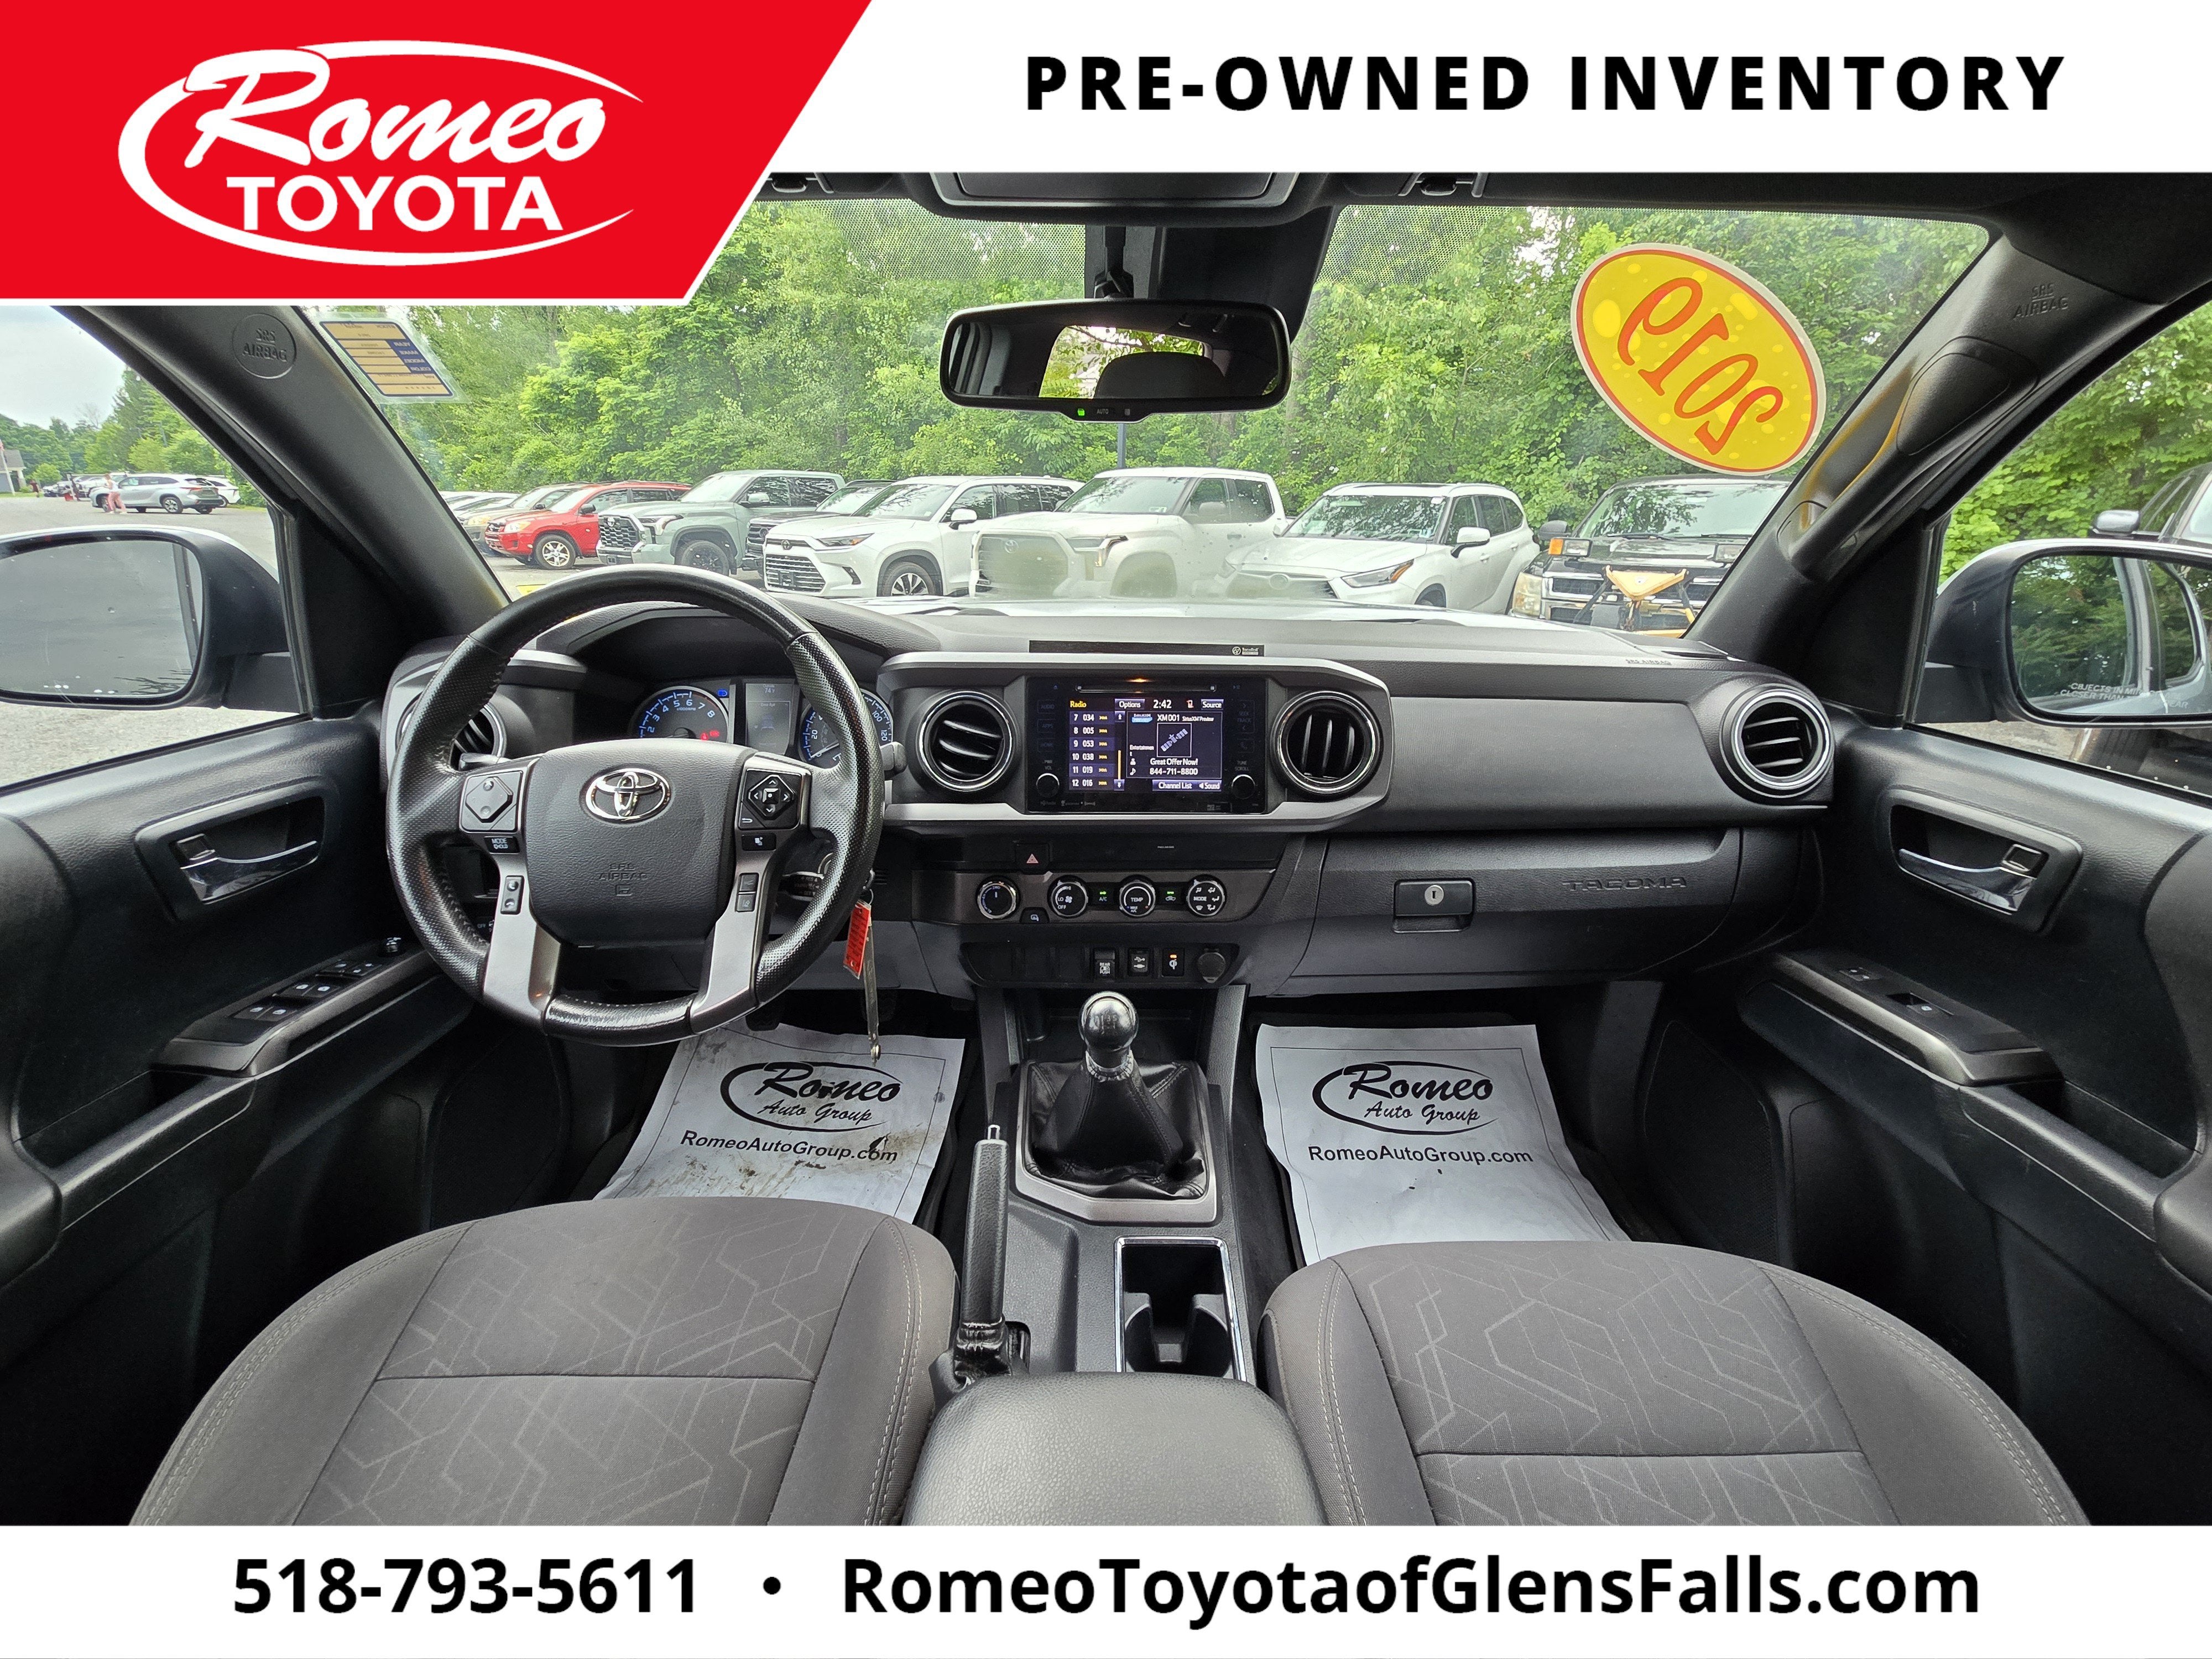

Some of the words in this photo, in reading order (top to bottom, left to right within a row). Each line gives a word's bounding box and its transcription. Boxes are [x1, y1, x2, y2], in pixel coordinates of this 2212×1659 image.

[2012, 297, 2069, 321] AIRBAG
[255, 327, 275, 343] SRS
[242, 343, 287, 362] AIRBAG
[2060, 690, 2098, 700] CLOSER
[2070, 682, 2112, 692] OBJECTS
[2113, 686, 2124, 694] IN
[698, 702, 706, 710] 7
[1153, 700, 1172, 708] 2:42
[707, 709, 715, 718] 8
[872, 710, 883, 722] 100
[811, 729, 818, 739] 20
[1562, 877, 1687, 891] TACOMA
[754, 1061, 901, 1102] Romeo
[1343, 1062, 1494, 1102] Romeo
[758, 1099, 807, 1117] Auto
[814, 1102, 873, 1124] Group
[1364, 1100, 1413, 1118] Auto
[1421, 1104, 1481, 1125] Group
[680, 1129, 898, 1162] RomeoAutoGroup.com
[1308, 1145, 1534, 1166] RomeoAutoGroup.com
